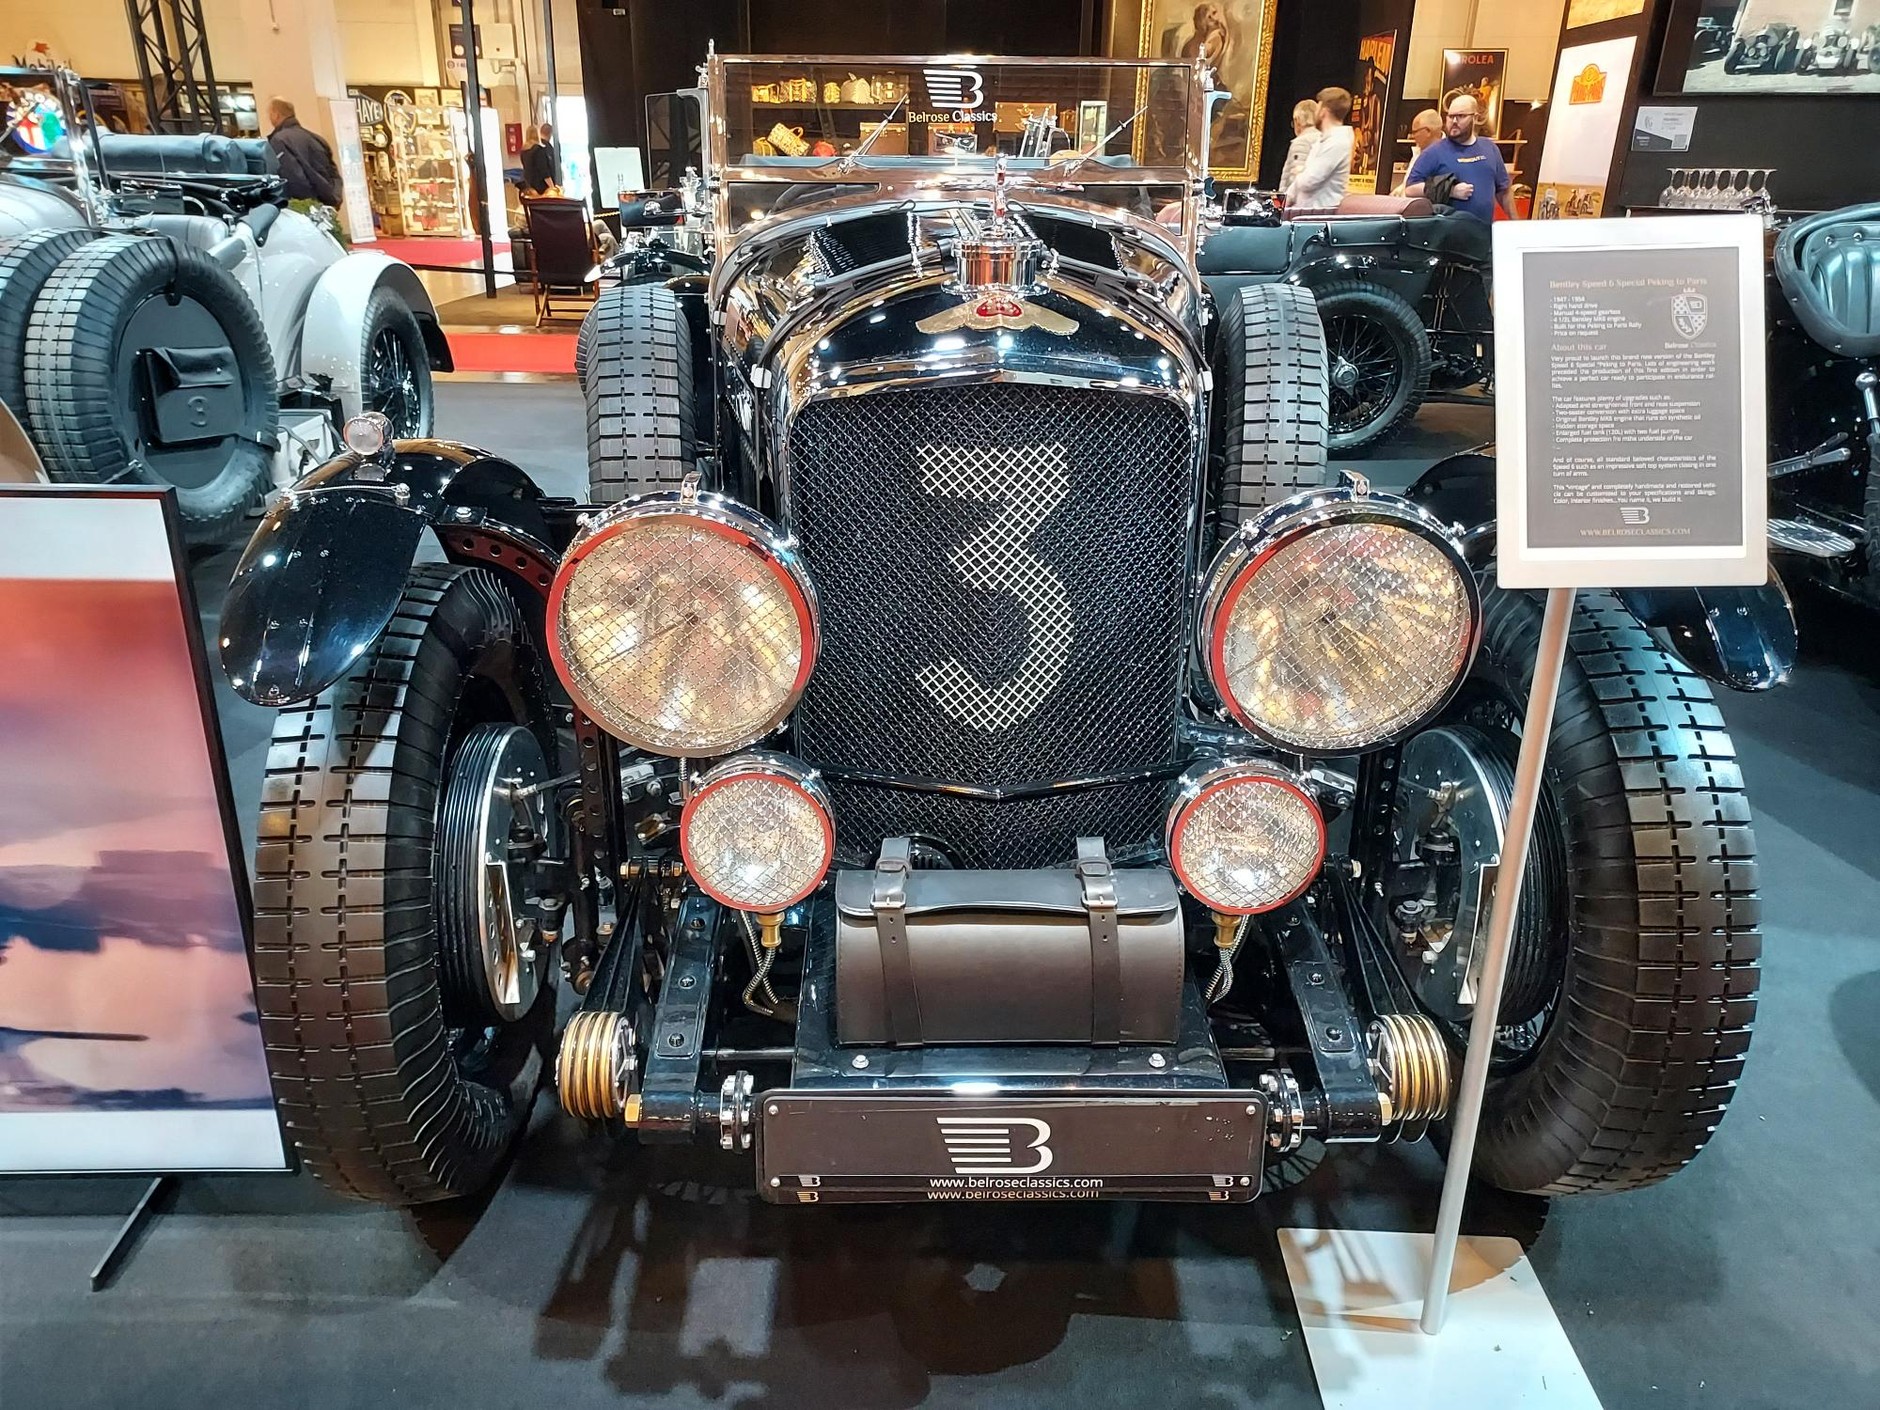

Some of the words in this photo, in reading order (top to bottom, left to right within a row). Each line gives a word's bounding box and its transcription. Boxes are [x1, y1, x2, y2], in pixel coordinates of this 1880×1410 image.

[908, 111, 950, 123] Belrose
[952, 110, 998, 123] Classics
[916, 442, 1075, 731] 3
[930, 1177, 1103, 1188] www.belroseclassics.com
